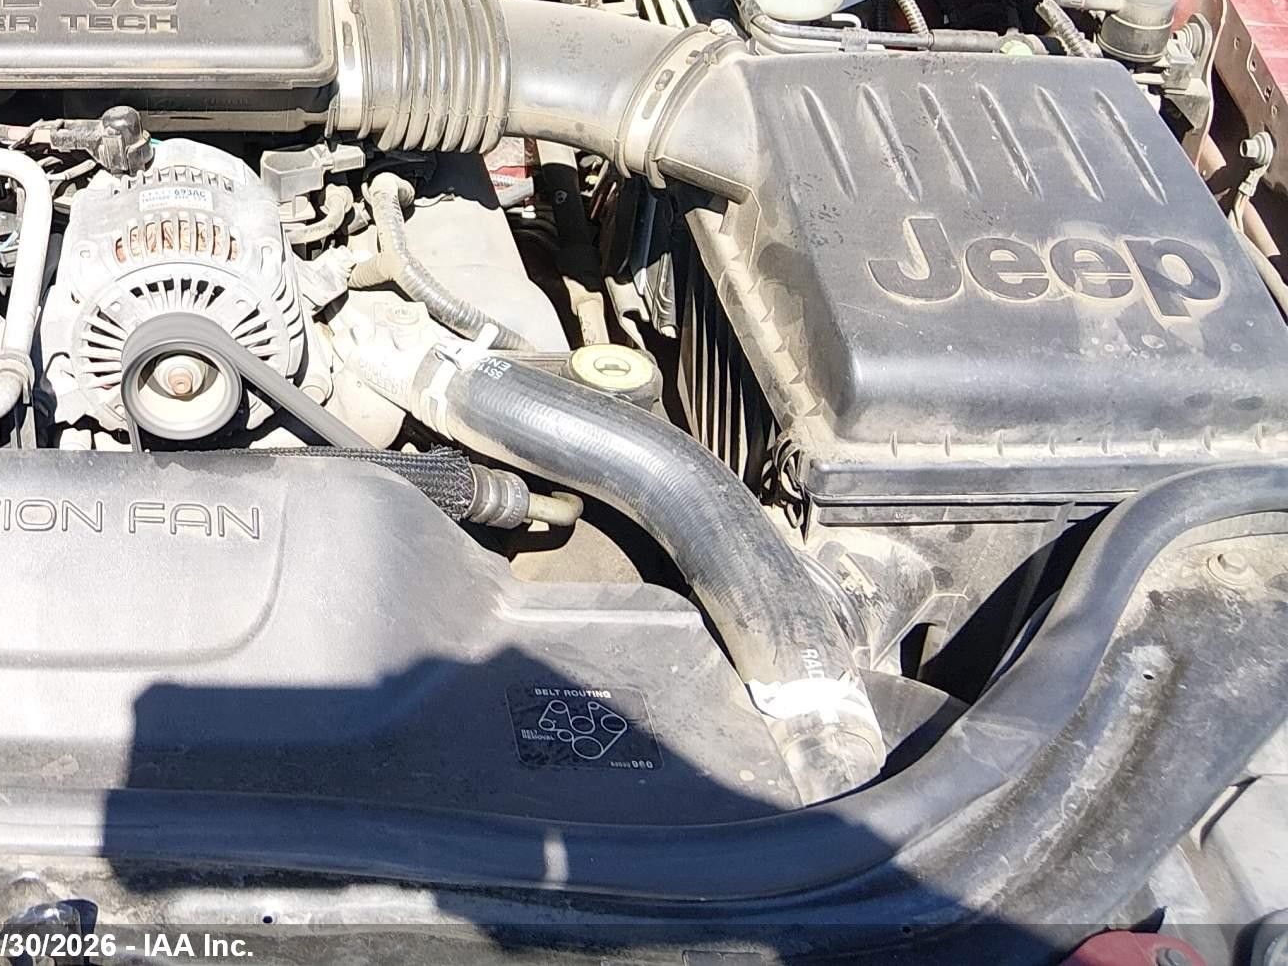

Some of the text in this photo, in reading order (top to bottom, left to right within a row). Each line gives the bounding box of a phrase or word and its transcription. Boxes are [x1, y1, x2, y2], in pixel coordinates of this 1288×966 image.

[60, 13, 180, 33] TECH
[866, 216, 1224, 322] Jeep
[128, 501, 260, 540] FAN
[534, 688, 612, 699] BELT ROUTING
